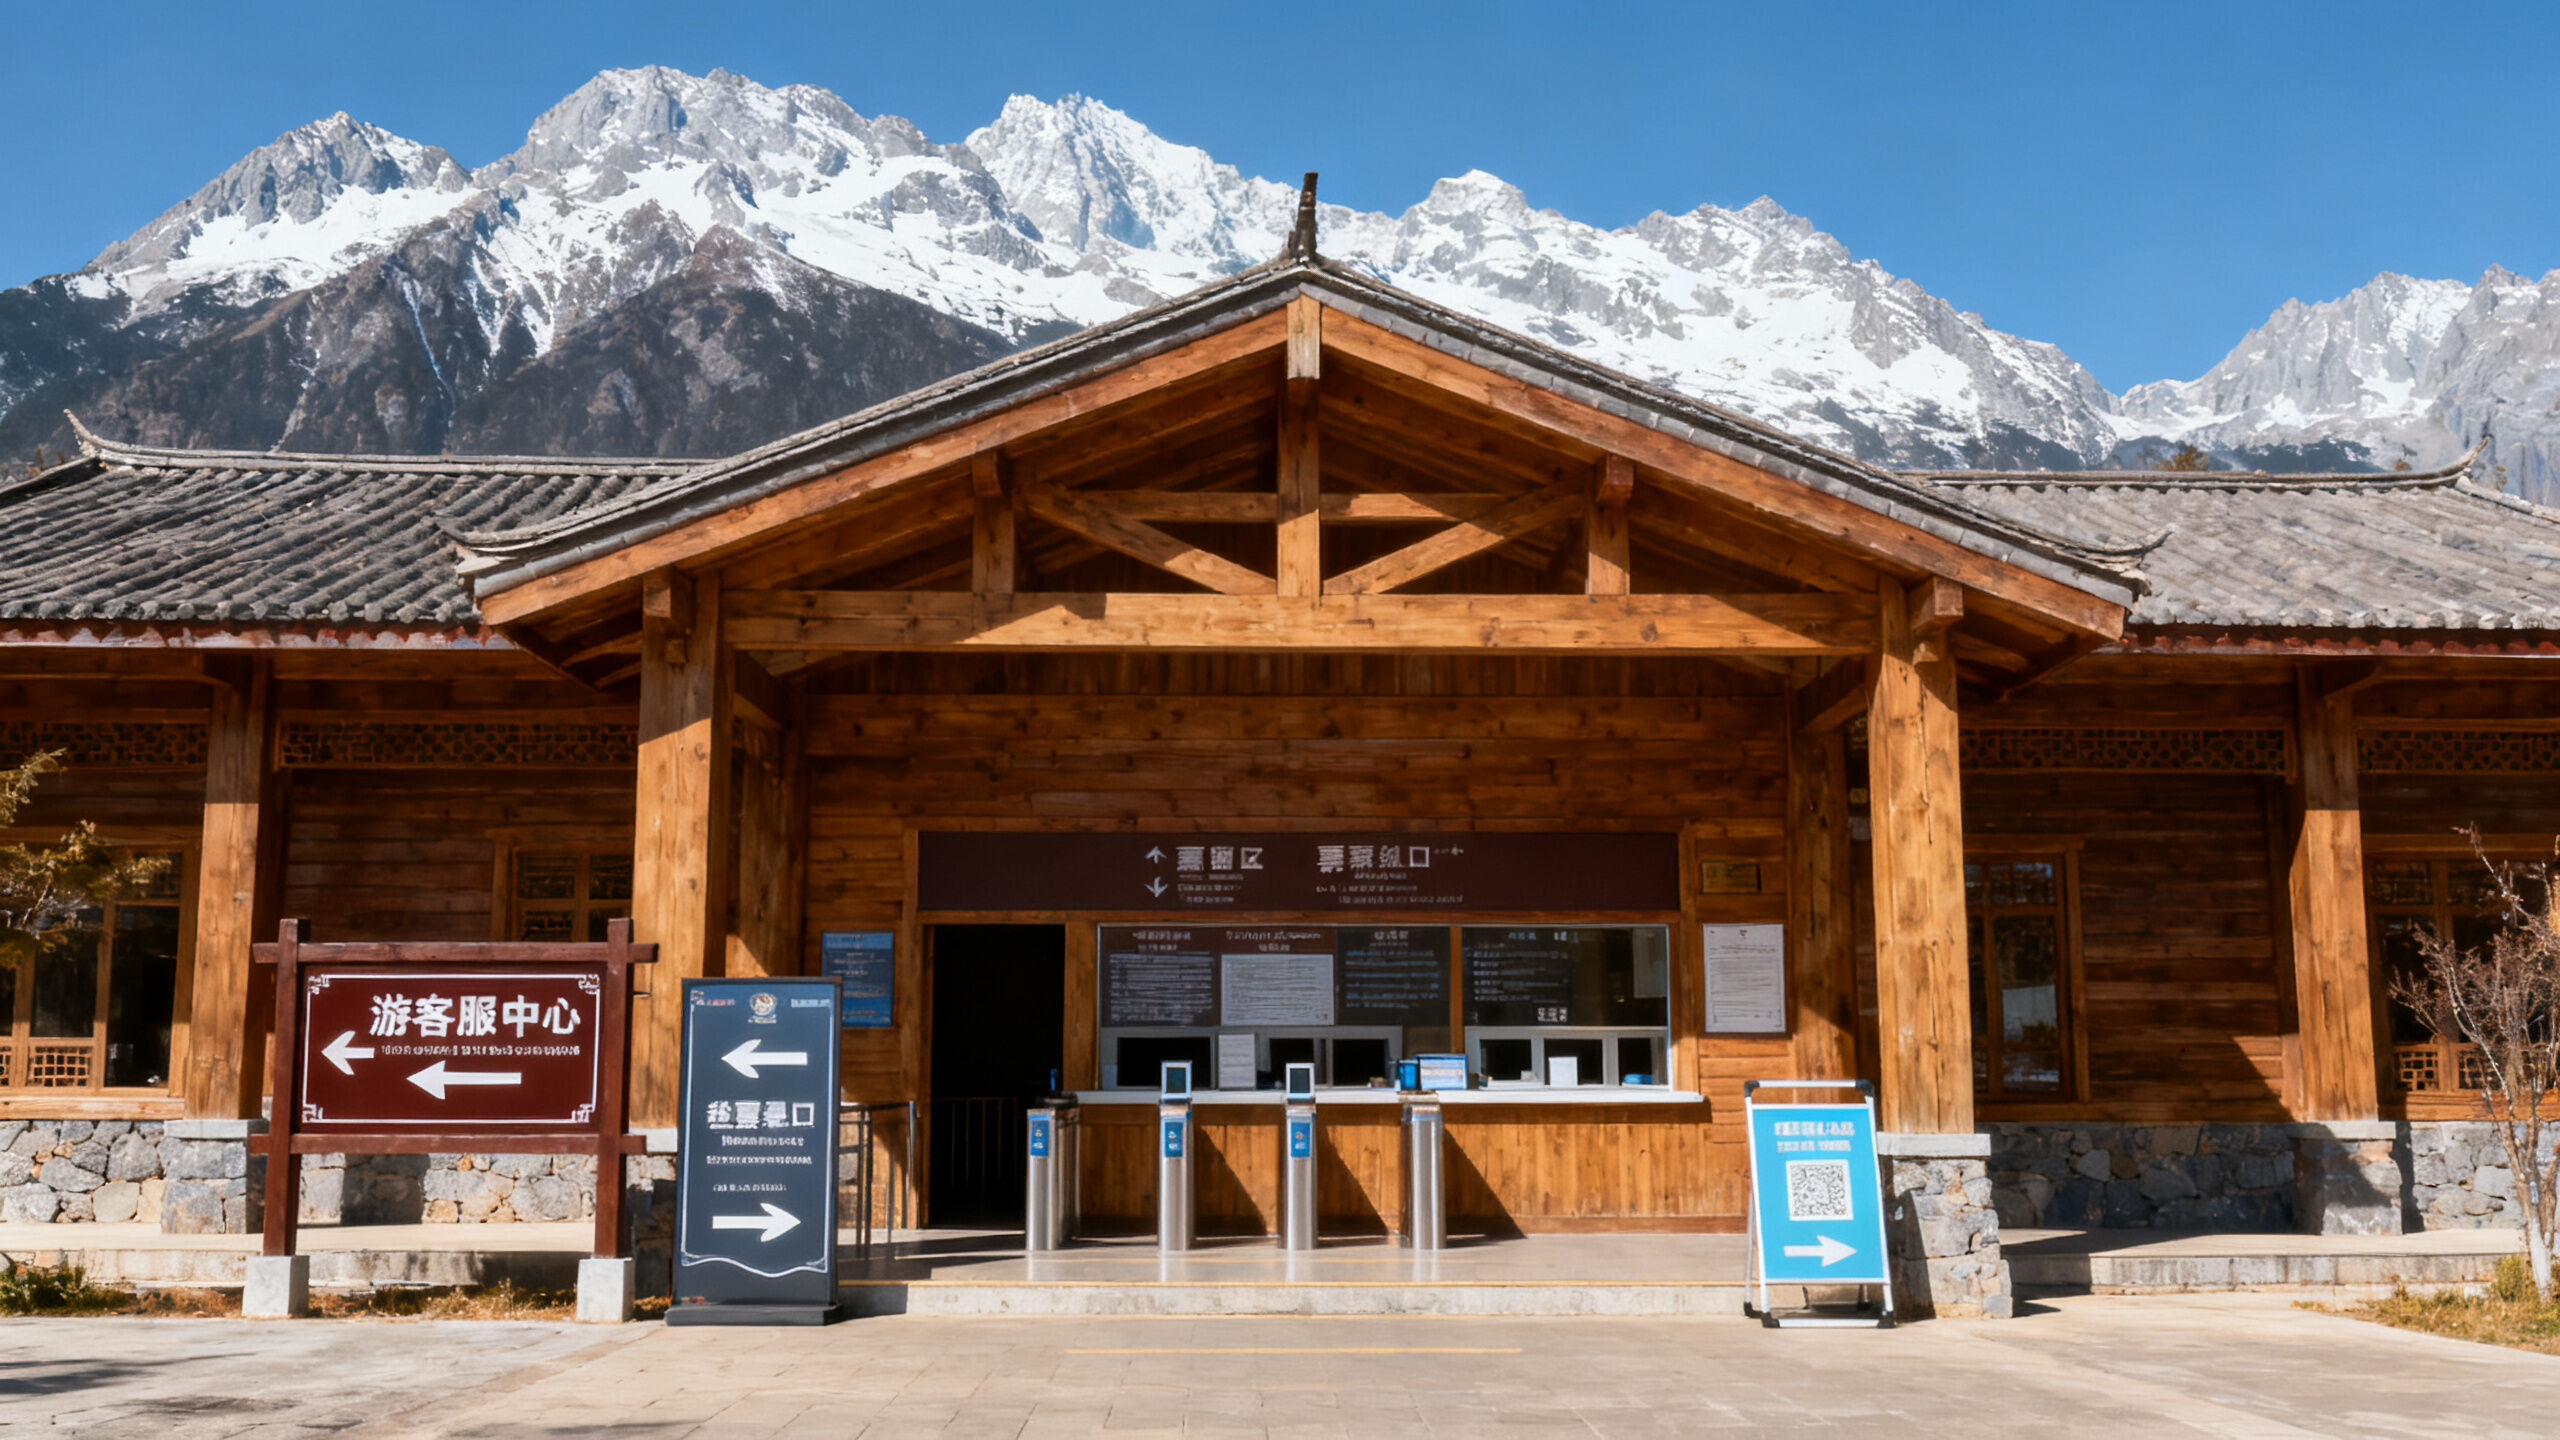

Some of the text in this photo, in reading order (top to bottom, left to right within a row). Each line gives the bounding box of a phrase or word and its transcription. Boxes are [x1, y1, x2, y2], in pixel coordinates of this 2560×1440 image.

[369, 993, 581, 1038] 游客服中心
